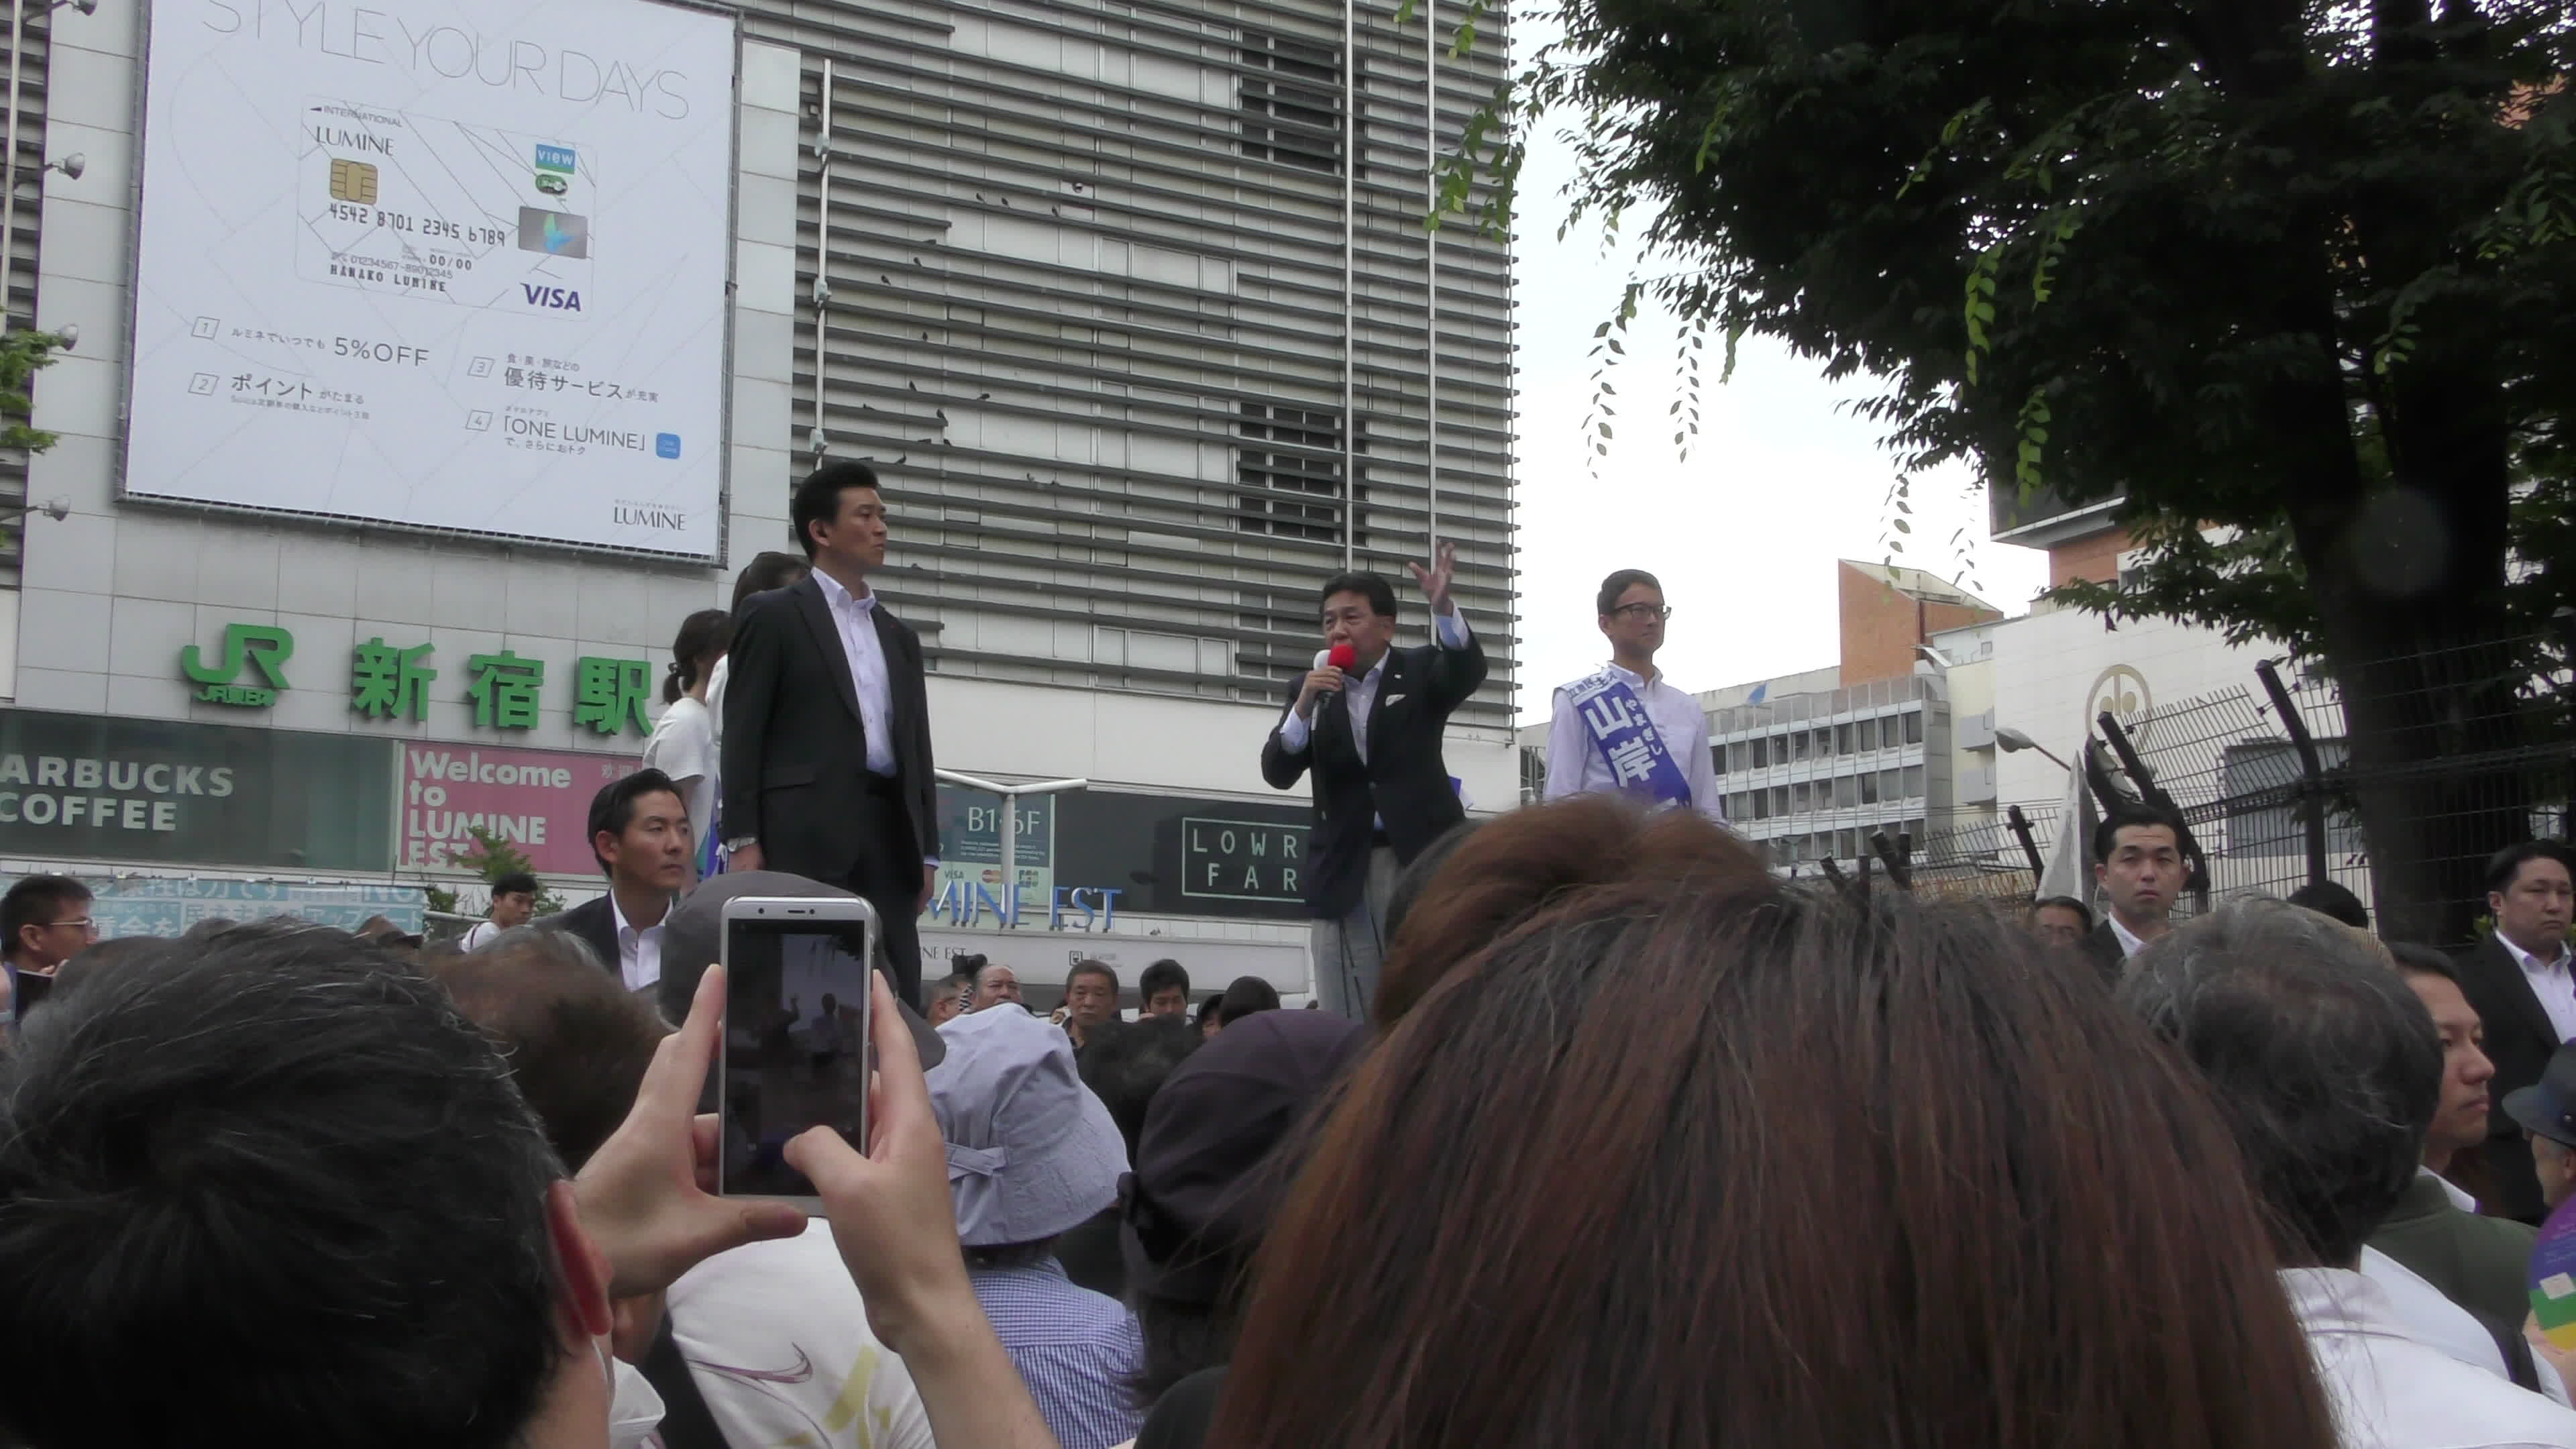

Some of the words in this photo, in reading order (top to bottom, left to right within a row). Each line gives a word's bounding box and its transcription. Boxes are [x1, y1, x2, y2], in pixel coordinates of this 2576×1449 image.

[397, 17, 547, 94] YOUR
[560, 50, 689, 119] DAYS
[323, 105, 402, 127] INTERNATIONAL
[316, 125, 394, 156] LUMINE
[330, 203, 368, 224] 4542
[377, 211, 414, 232] 8701
[423, 218, 460, 239] 2345
[469, 226, 505, 247] 6789
[331, 264, 384, 283] HANAKO
[394, 273, 447, 292] LUMINE
[429, 254, 472, 271] 00/00
[520, 282, 581, 312] VISA
[334, 336, 431, 367] 5%OFF
[231, 373, 313, 401] ポイント
[504, 367, 624, 400] 優待サービス
[614, 506, 688, 531] LUMINE
[182, 623, 294, 690] JR
[352, 636, 655, 737] 新宿駅
[1584, 696, 1657, 788] 山岸
[409, 749, 572, 789] Welcome
[409, 780, 447, 807] to
[0, 791, 178, 831] COFFEE
[409, 808, 547, 845] LUMINE
[945, 869, 965, 879] VISA
[1208, 862, 1297, 892] FAR
[1049, 885, 1122, 931] EST
